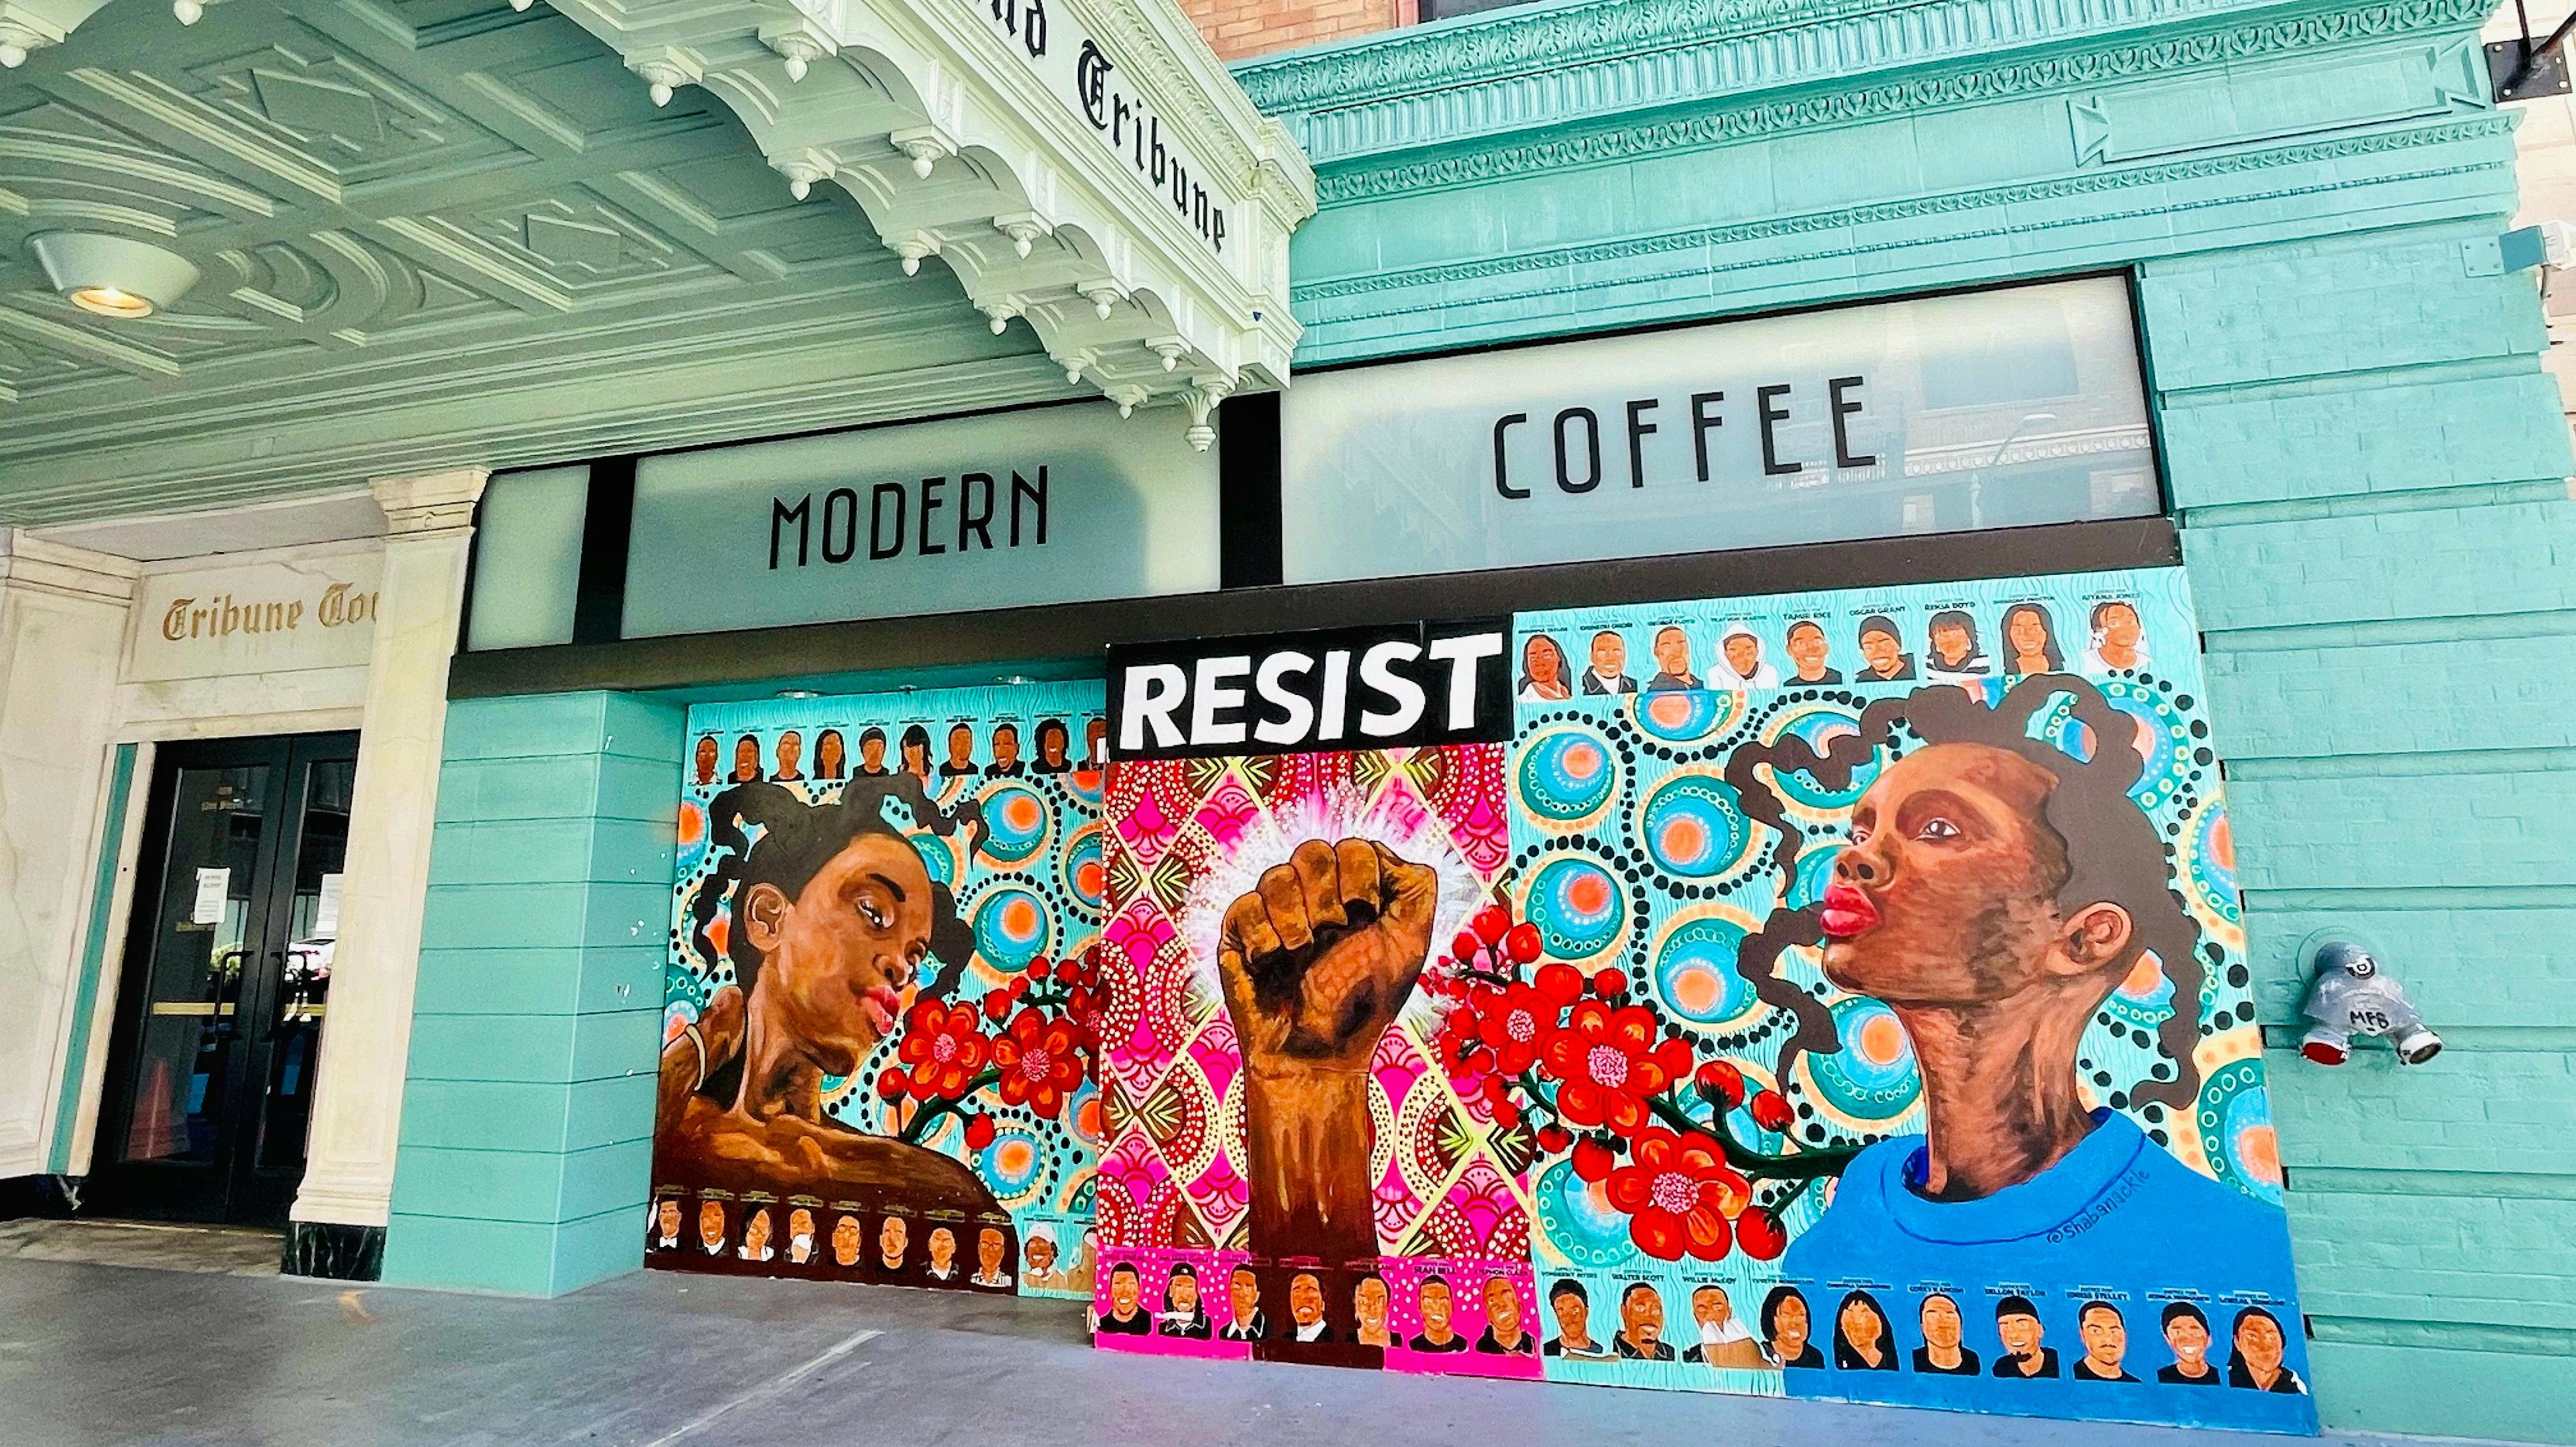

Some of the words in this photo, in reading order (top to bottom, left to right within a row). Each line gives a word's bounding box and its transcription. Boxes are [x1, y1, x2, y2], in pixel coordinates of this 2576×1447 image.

[1077, 39, 1226, 254] Tribune
[1493, 376, 1876, 500] COFFEE
[768, 465, 1049, 570] MODERN
[162, 594, 303, 641] Tribune
[1119, 632, 1503, 750] RESIST
[2350, 1010, 2390, 1029] MFB
